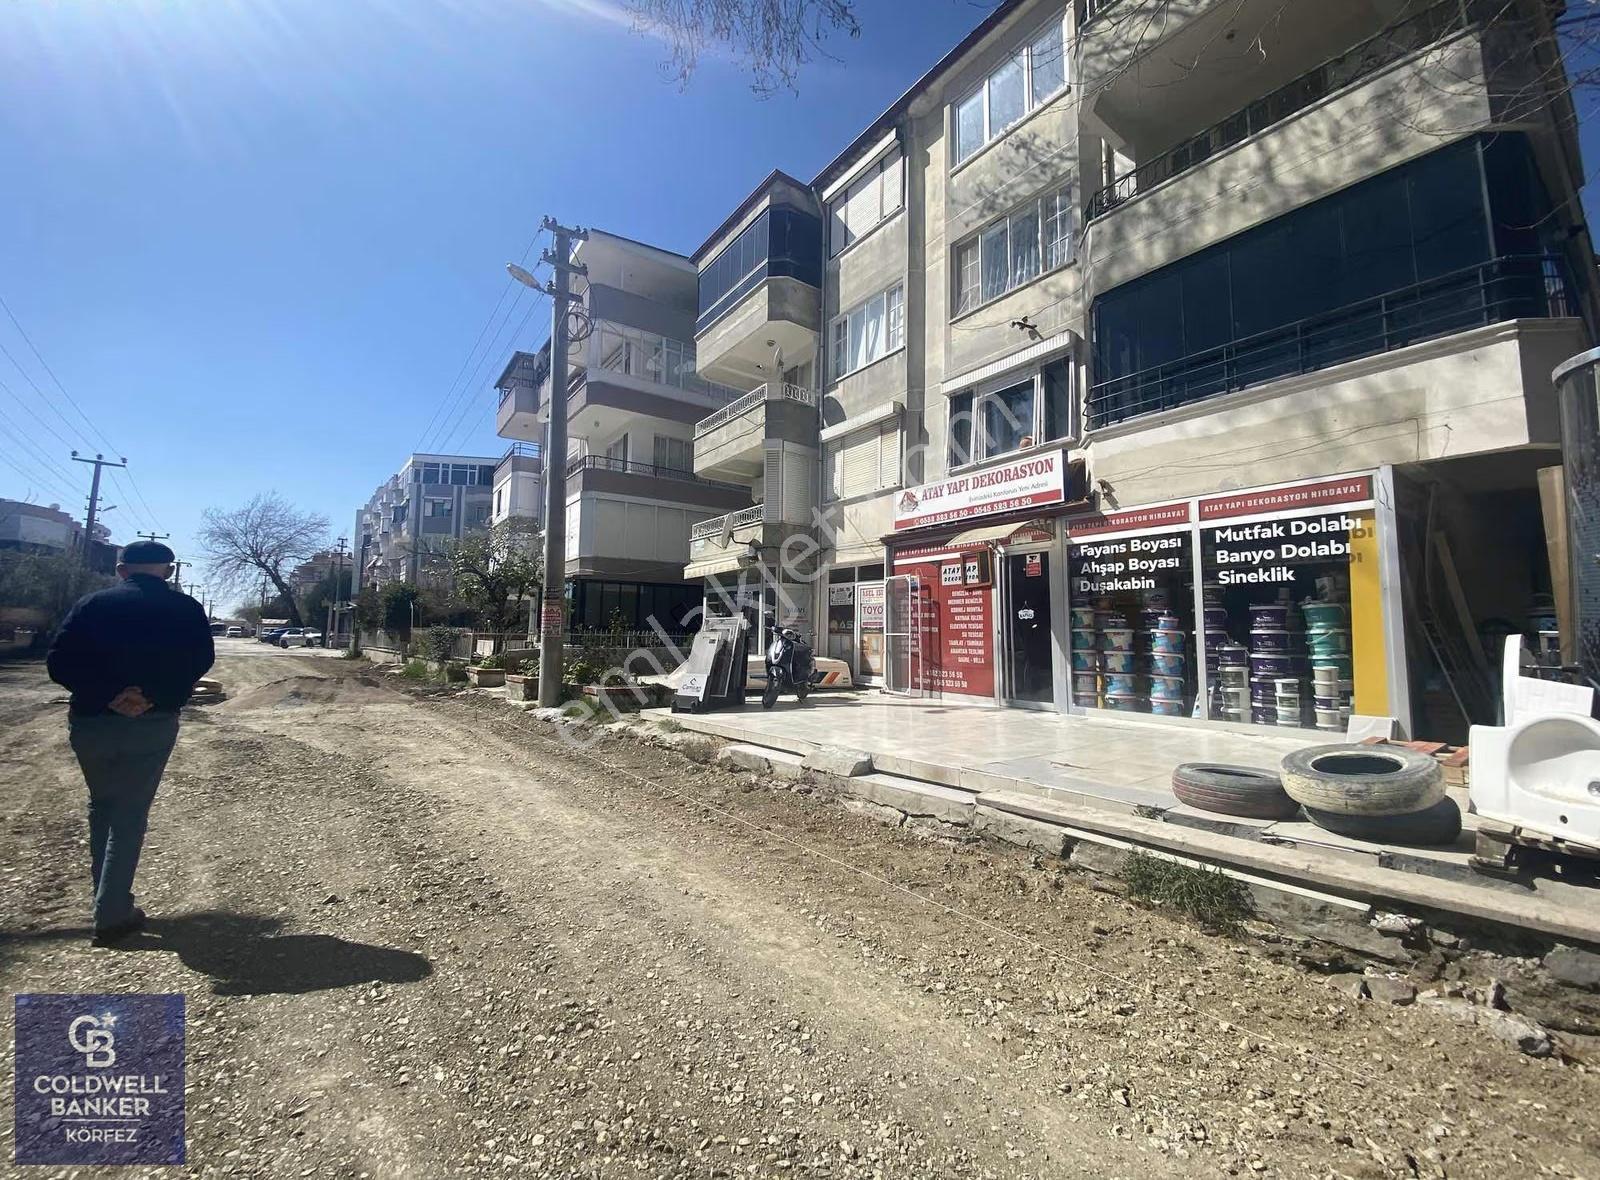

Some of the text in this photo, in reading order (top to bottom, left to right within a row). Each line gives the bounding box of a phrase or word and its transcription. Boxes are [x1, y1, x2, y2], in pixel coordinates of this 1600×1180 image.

[922, 458, 1054, 501] ATAY YAPI DEKORASYON
[1031, 481, 1048, 490] Adresi
[1204, 504, 1223, 512] ATAY
[1248, 492, 1308, 506] DEKORASYON
[1311, 484, 1362, 498] HIRDAVAT
[959, 510, 968, 518] 50
[974, 505, 992, 514] 0545
[993, 502, 1008, 512] 523
[1021, 497, 1032, 506] 50
[1150, 510, 1185, 520] HIRDAVAT
[1216, 515, 1361, 543] Mutfak Dolabı
[1080, 538, 1182, 558] Fayans Boyası
[1216, 540, 1351, 564] Banyo Dolabı
[943, 566, 960, 575] ATAY
[1080, 558, 1180, 576] Ahşap Boyası
[1218, 566, 1296, 584] Sineklik
[1080, 576, 1155, 594] Duşakabin
[863, 606, 883, 615] TOYO
